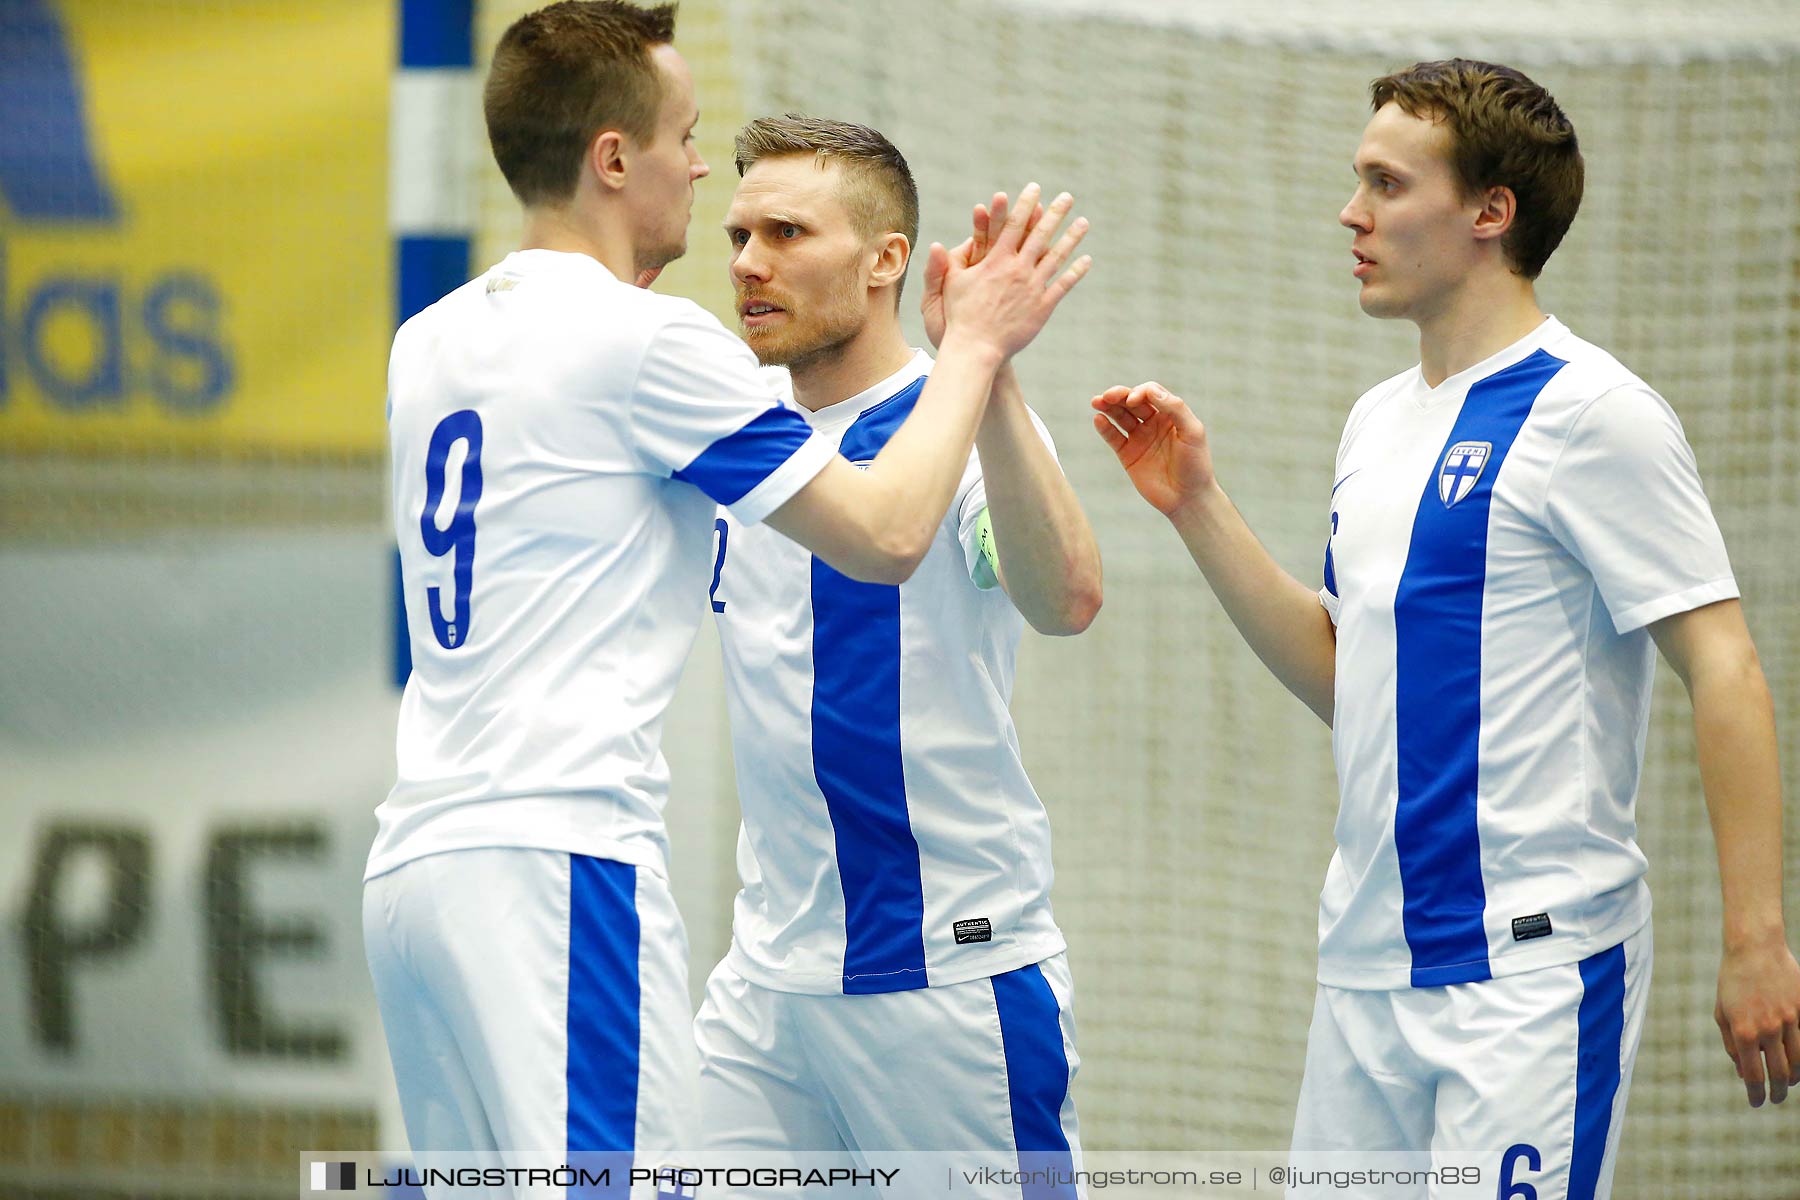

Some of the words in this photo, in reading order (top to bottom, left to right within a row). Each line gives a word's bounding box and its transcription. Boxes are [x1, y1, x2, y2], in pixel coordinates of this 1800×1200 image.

[0, 268, 238, 420] as
[420, 409, 484, 650] 9
[22, 814, 350, 1061] PE
[1498, 1143, 1541, 1200] 6
